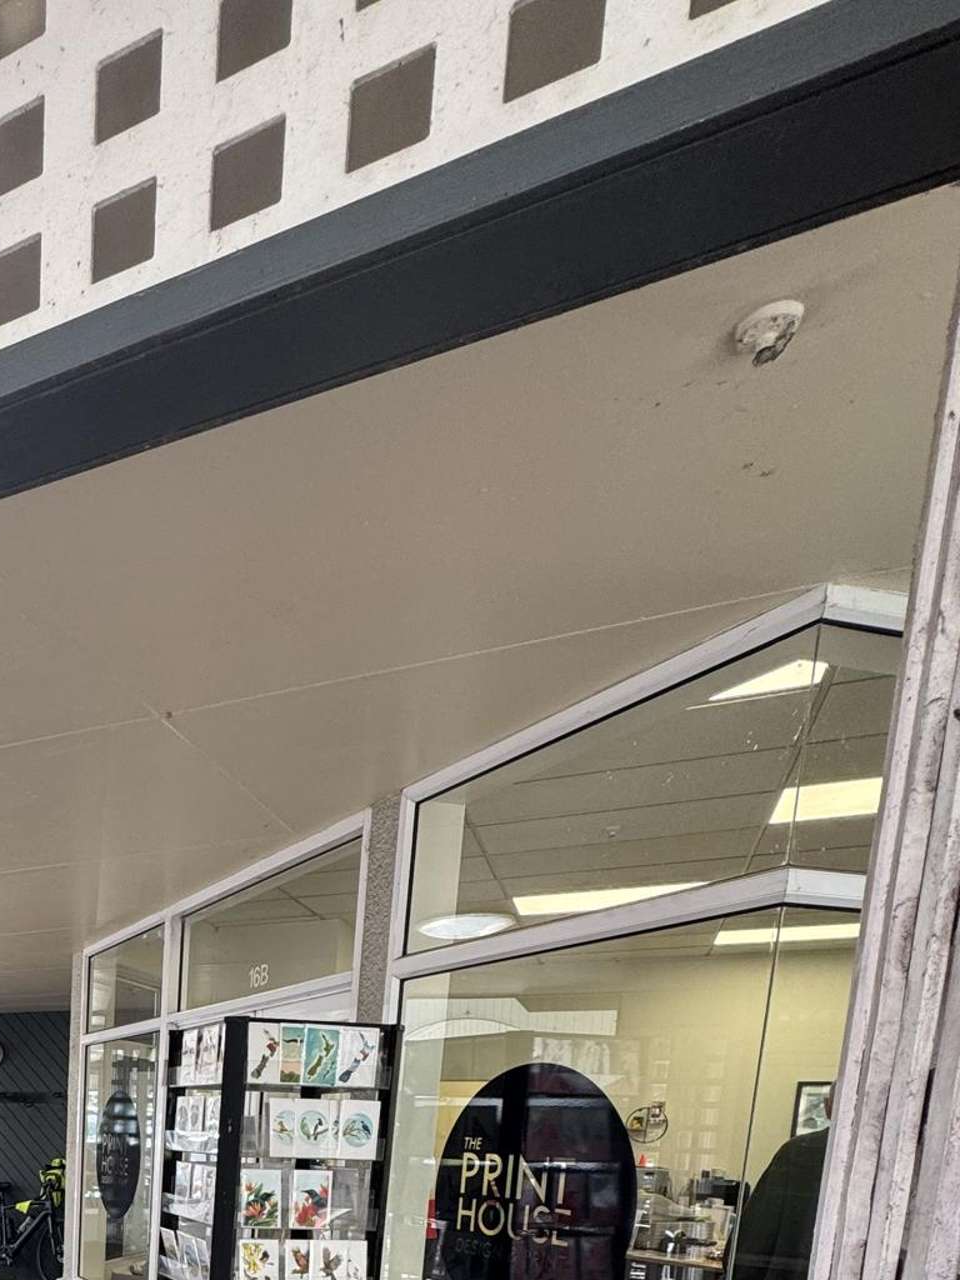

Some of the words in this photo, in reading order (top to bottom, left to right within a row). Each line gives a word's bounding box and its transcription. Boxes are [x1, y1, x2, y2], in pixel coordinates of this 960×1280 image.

[249, 964, 269, 988] 16B
[464, 1137, 483, 1150] THE
[460, 1152, 576, 1204] PRINT
[456, 1197, 572, 1247] HOUSE
[455, 1238, 505, 1261] DESIG
